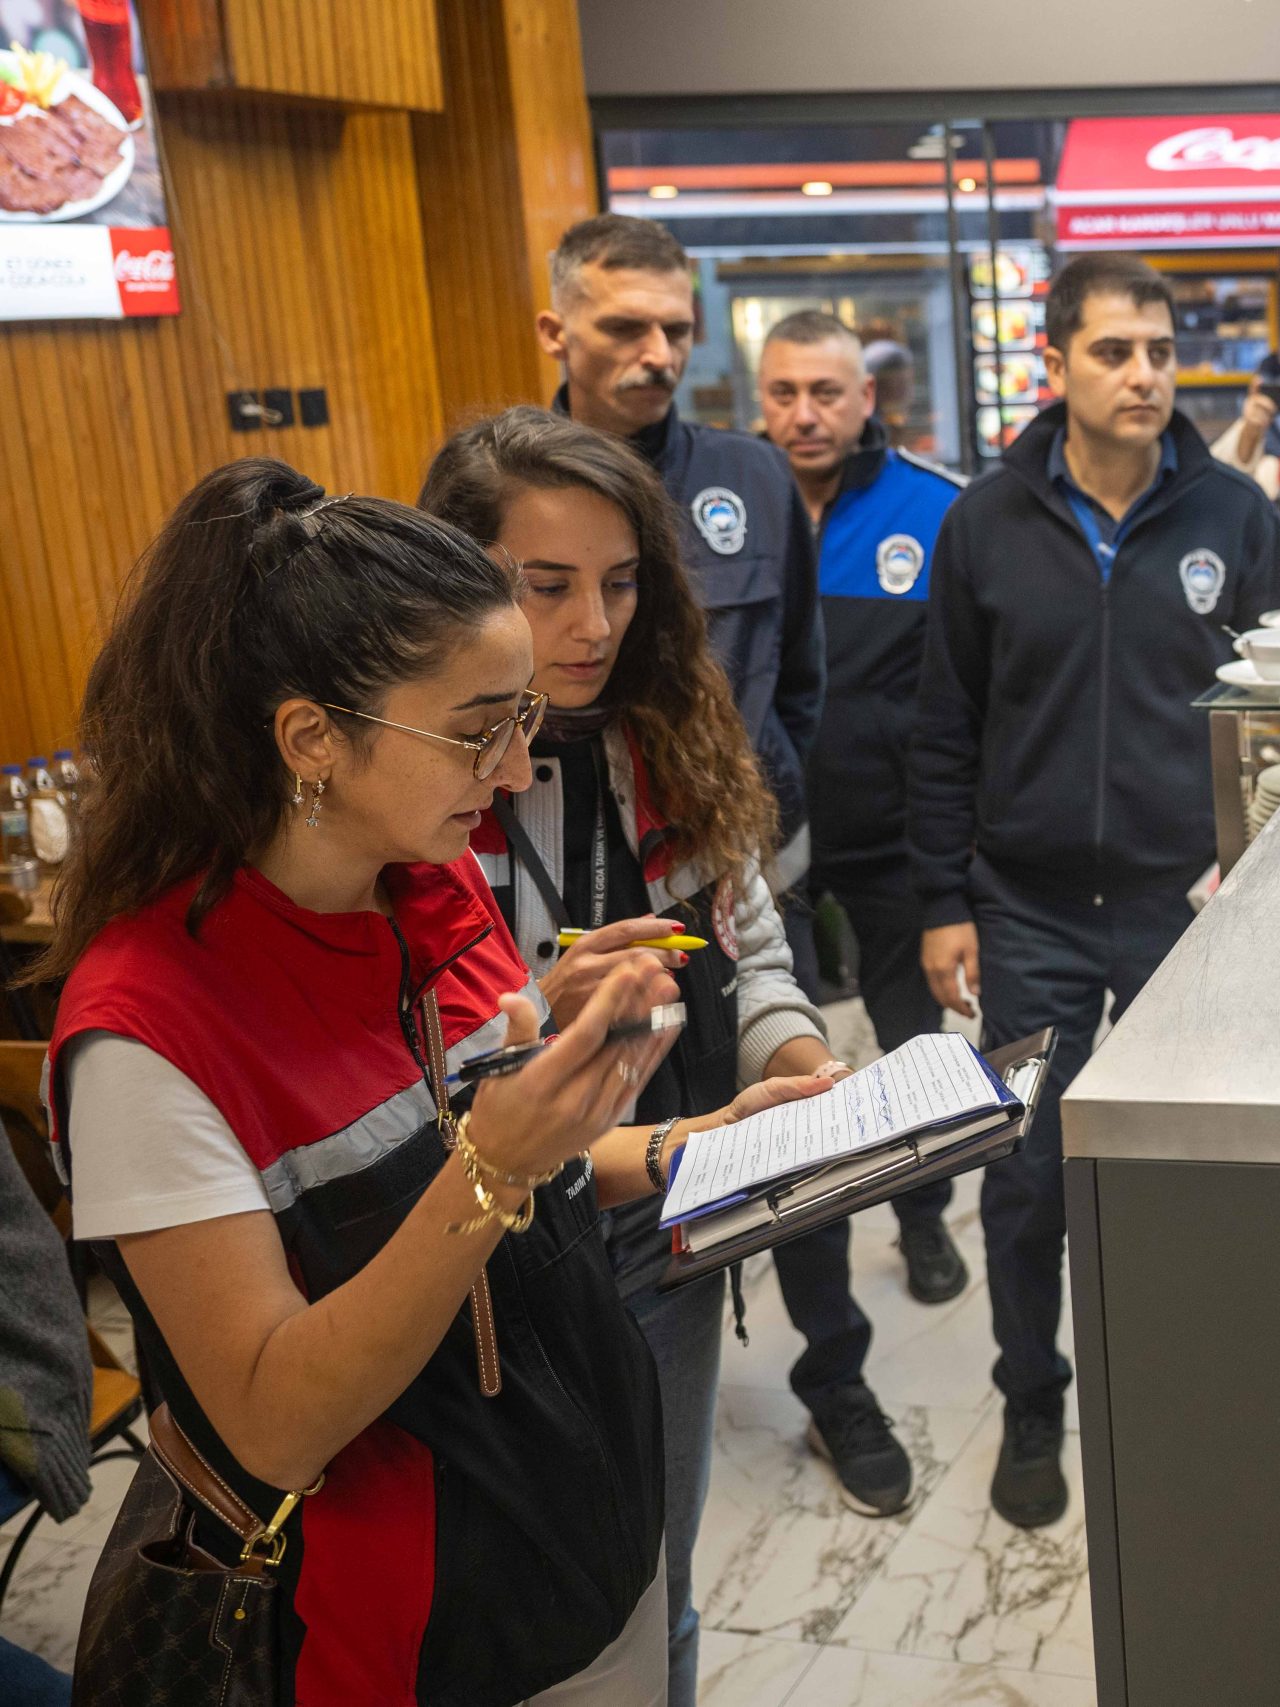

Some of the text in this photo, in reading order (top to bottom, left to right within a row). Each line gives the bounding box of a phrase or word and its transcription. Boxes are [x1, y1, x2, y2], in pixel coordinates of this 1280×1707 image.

[595, 840, 606, 866] TARIM
[595, 868, 606, 891] GIDA
[565, 1174, 587, 1200] TARIM
